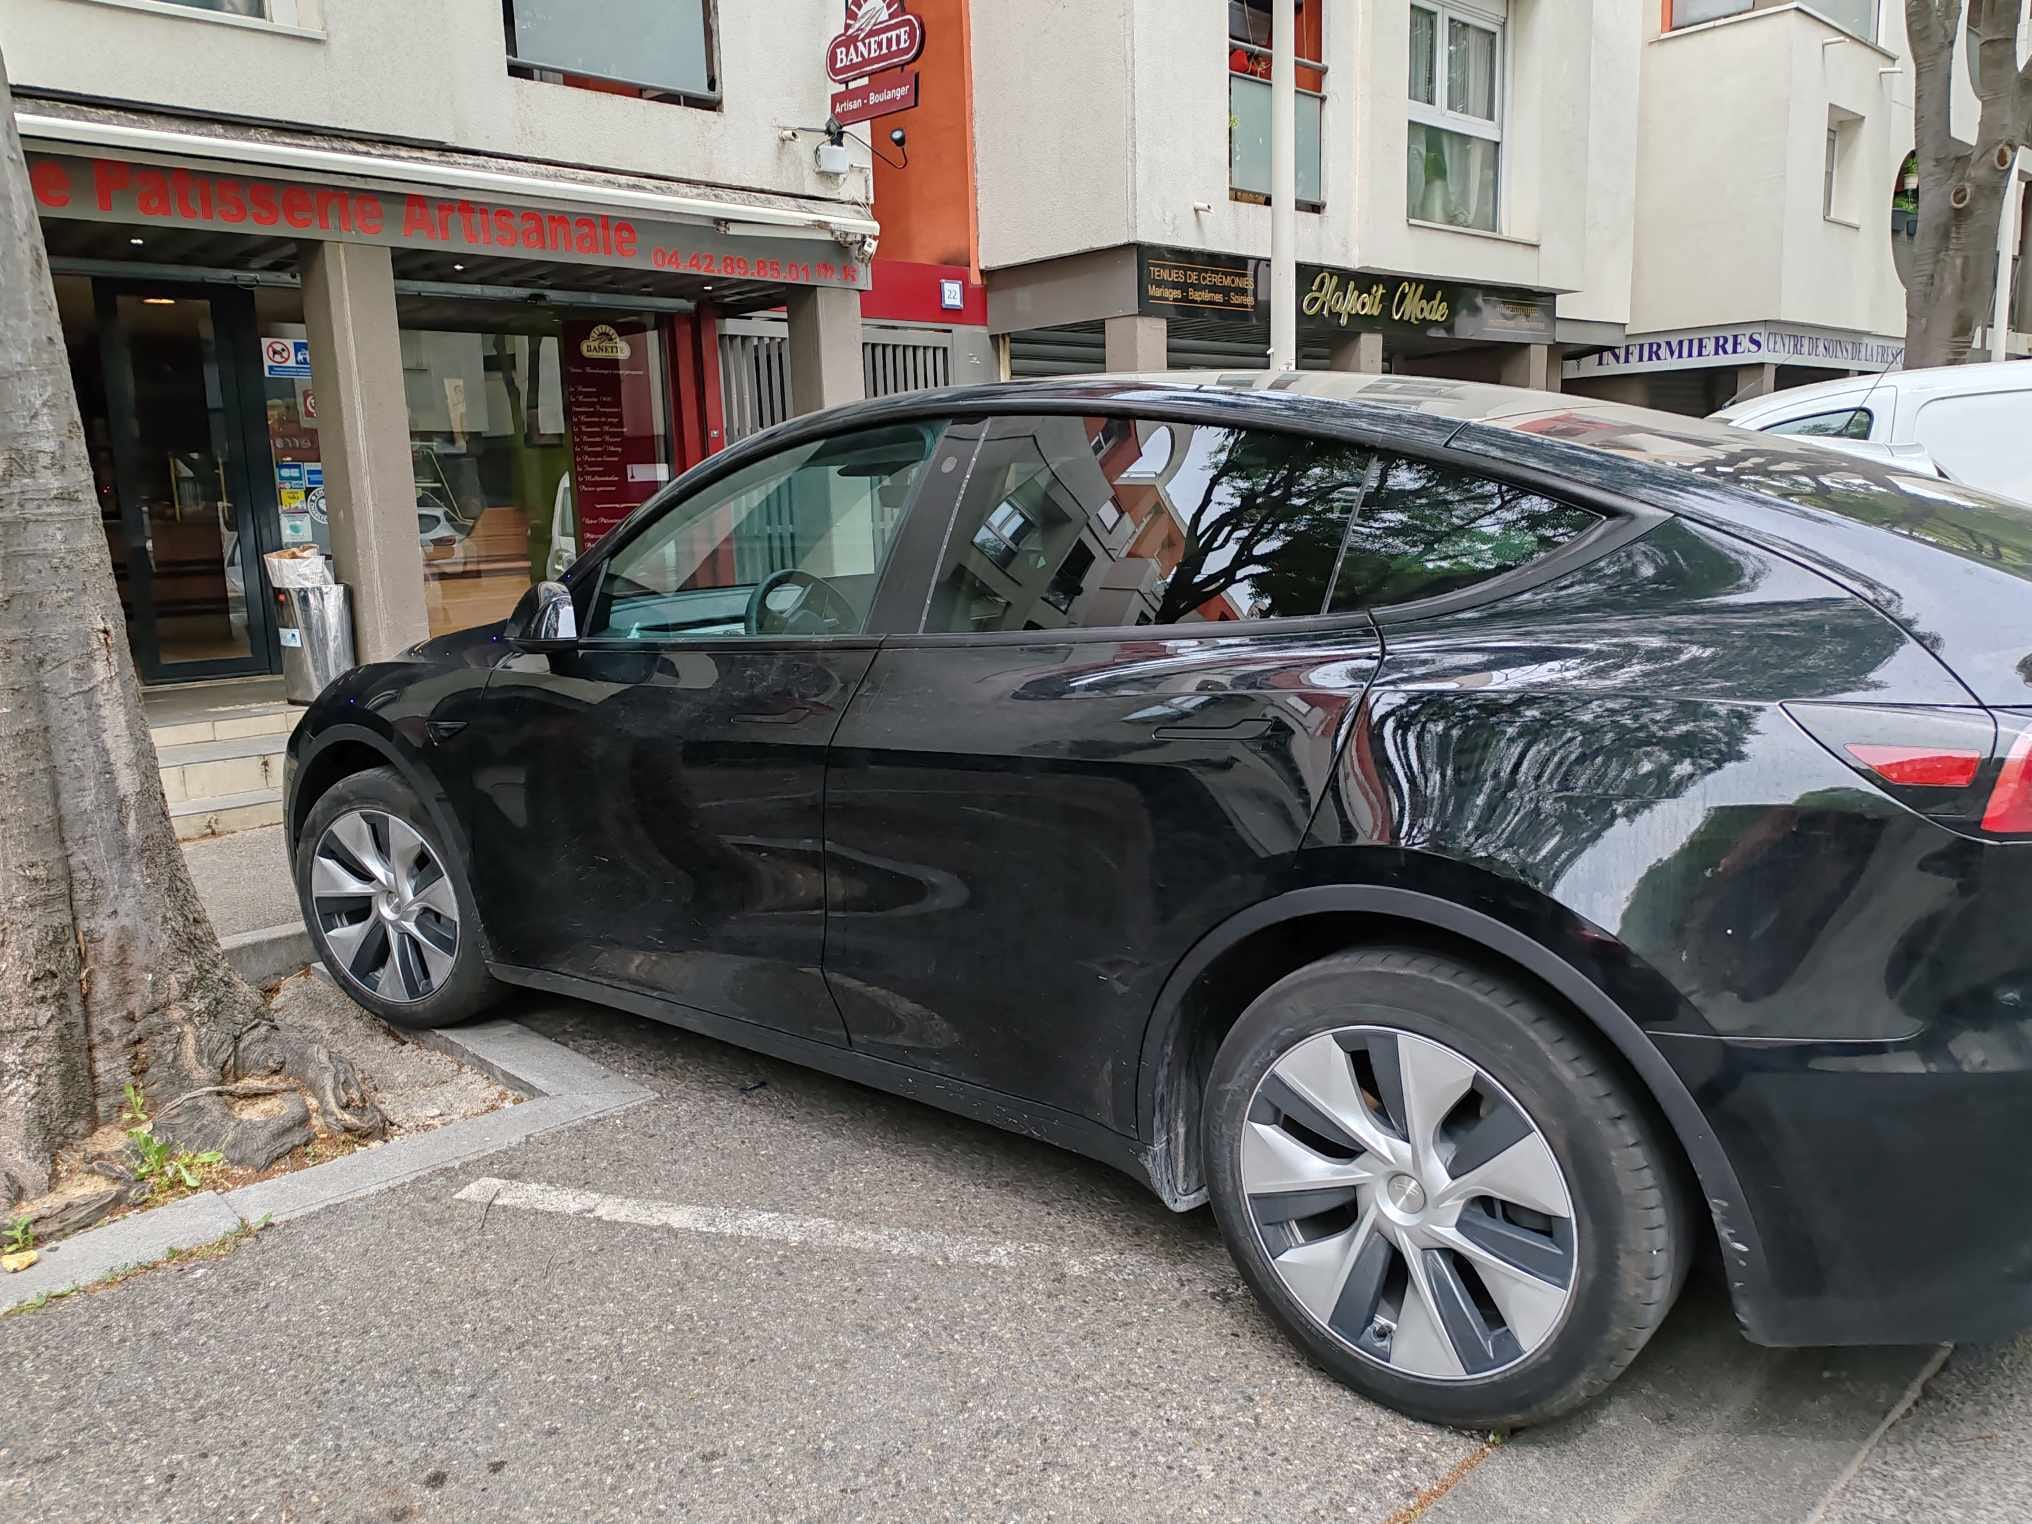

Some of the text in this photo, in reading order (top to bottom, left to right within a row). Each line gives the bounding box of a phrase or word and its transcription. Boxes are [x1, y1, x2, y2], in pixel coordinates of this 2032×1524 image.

[835, 26, 910, 69] BANETTE
[834, 98, 863, 114] Artisan
[868, 84, 910, 105] Boulanger
[403, 192, 638, 258] Artisanale
[1149, 266, 1185, 282] TENUES
[1186, 270, 1199, 284] DE
[947, 288, 958, 300] 22
[1148, 283, 1182, 300] Mariages
[1392, 281, 1449, 325] Mode
[1596, 330, 1763, 367] INFIRMIERES
[1766, 331, 1806, 355] CENTRE
[1807, 336, 1820, 357] DE
[1822, 337, 1849, 360] SOINS
[1849, 340, 1863, 361] DE
